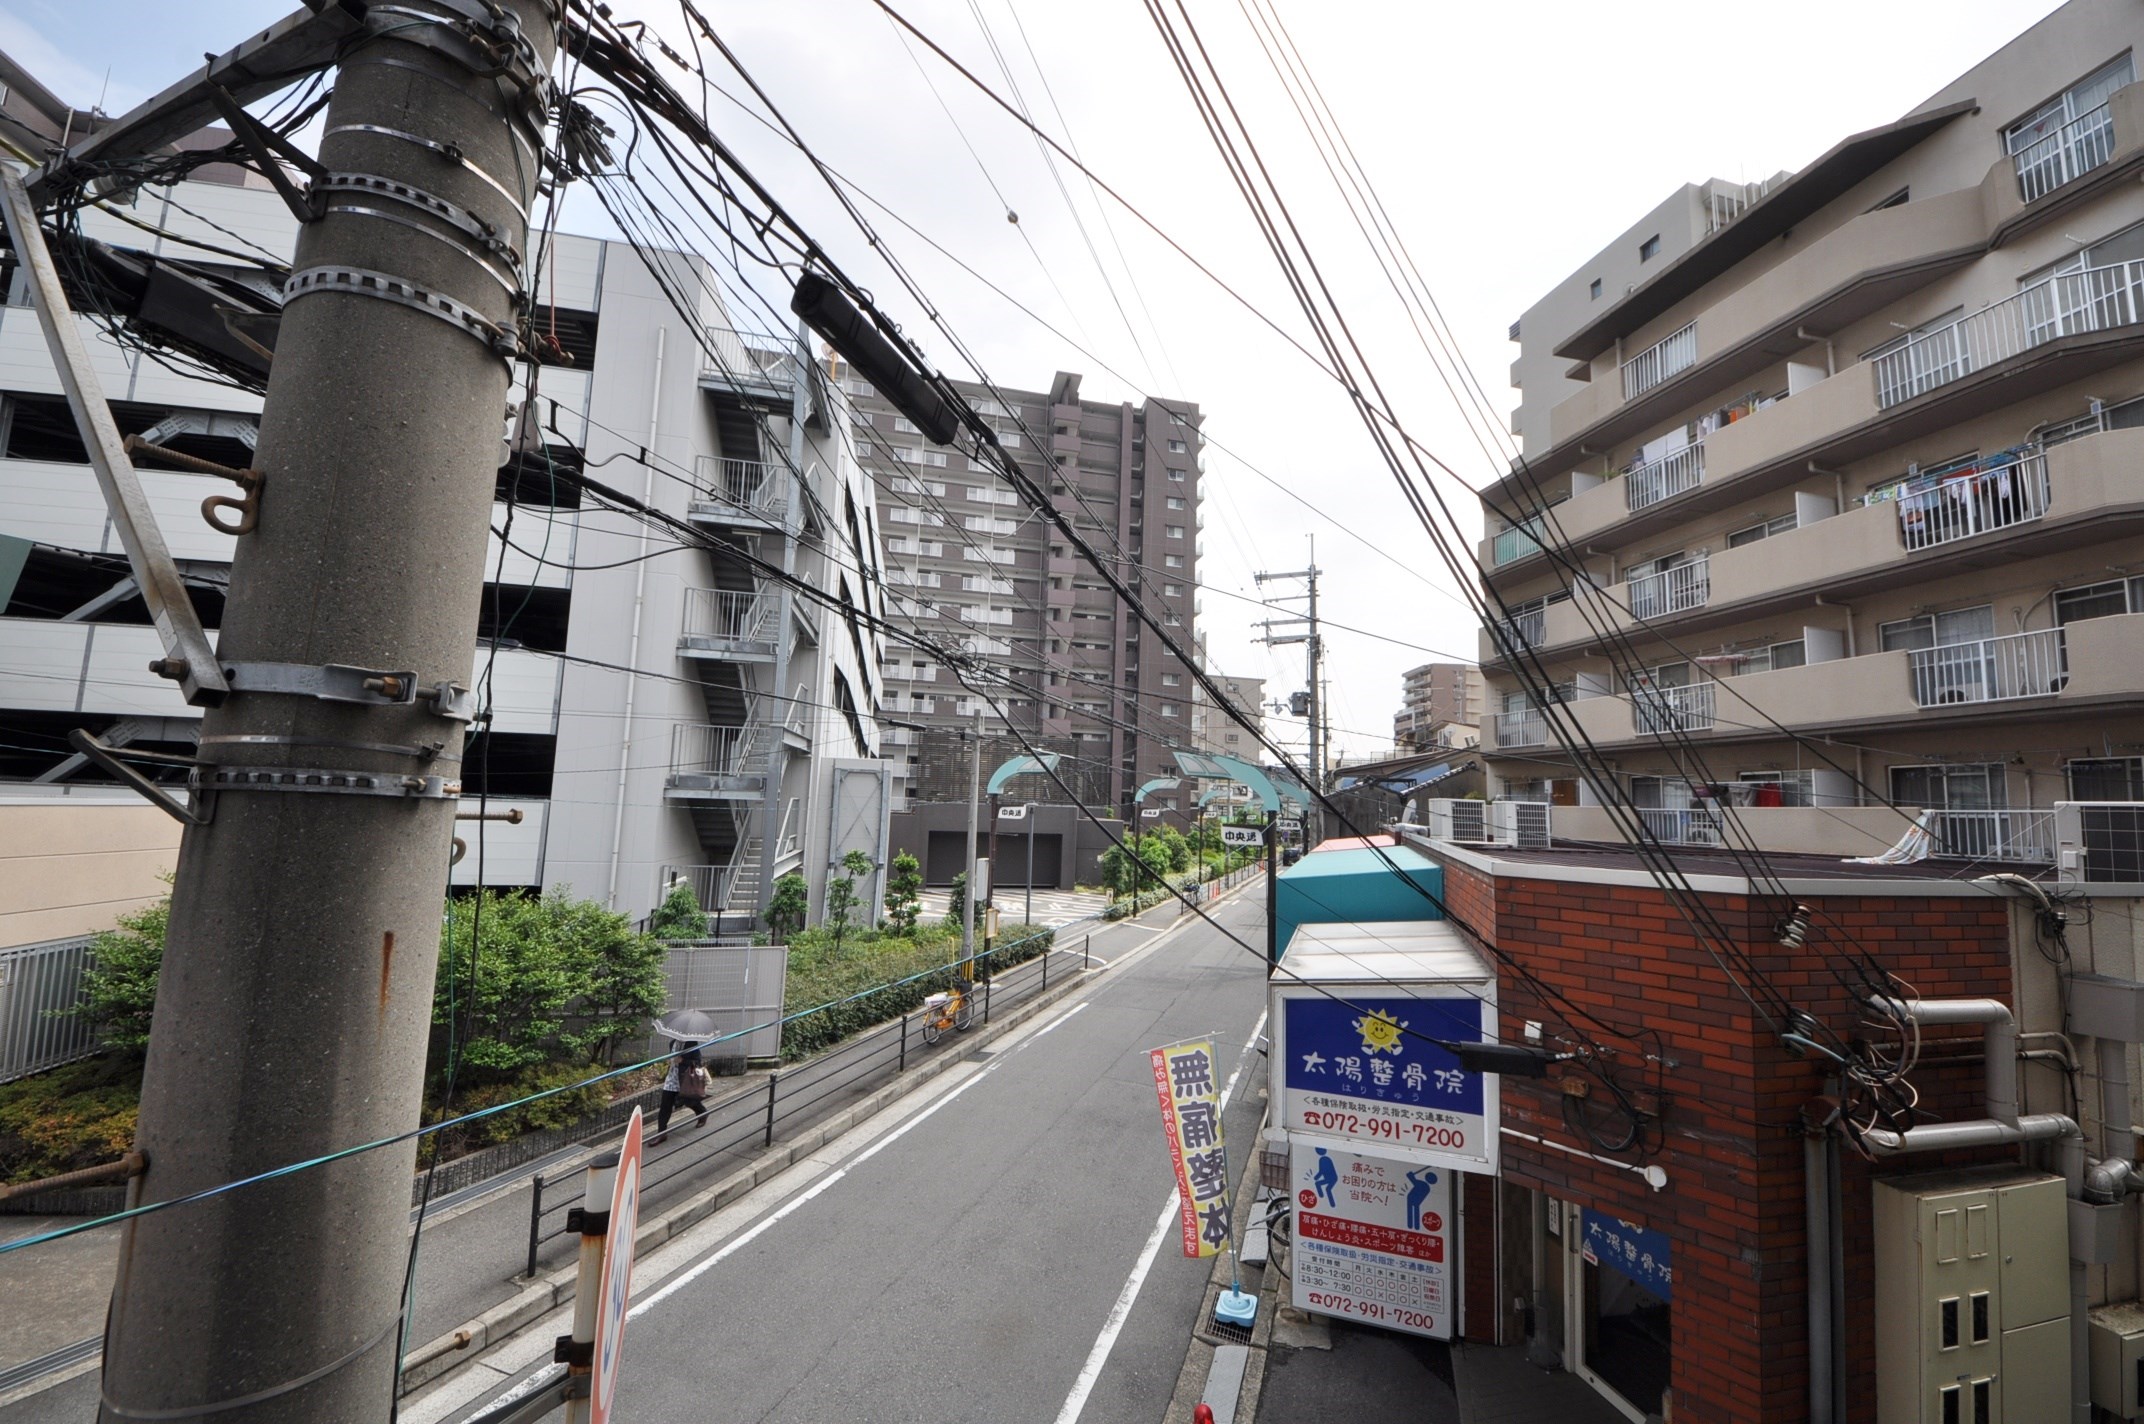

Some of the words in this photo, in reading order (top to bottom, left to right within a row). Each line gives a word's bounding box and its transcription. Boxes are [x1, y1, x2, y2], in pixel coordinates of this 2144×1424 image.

[1225, 831, 1257, 842] 中央通
[1302, 1051, 1465, 1095] 太陽整骨院
[1322, 1111, 1465, 1149] 072-991-7200
[1352, 1161, 1385, 1177] 痛みで
[1342, 1174, 1397, 1193] お困りの方は
[1301, 1193, 1315, 1205] ひざ
[1349, 1189, 1389, 1207] 当院へ!
[1323, 1294, 1434, 1330] 072-991-7200
